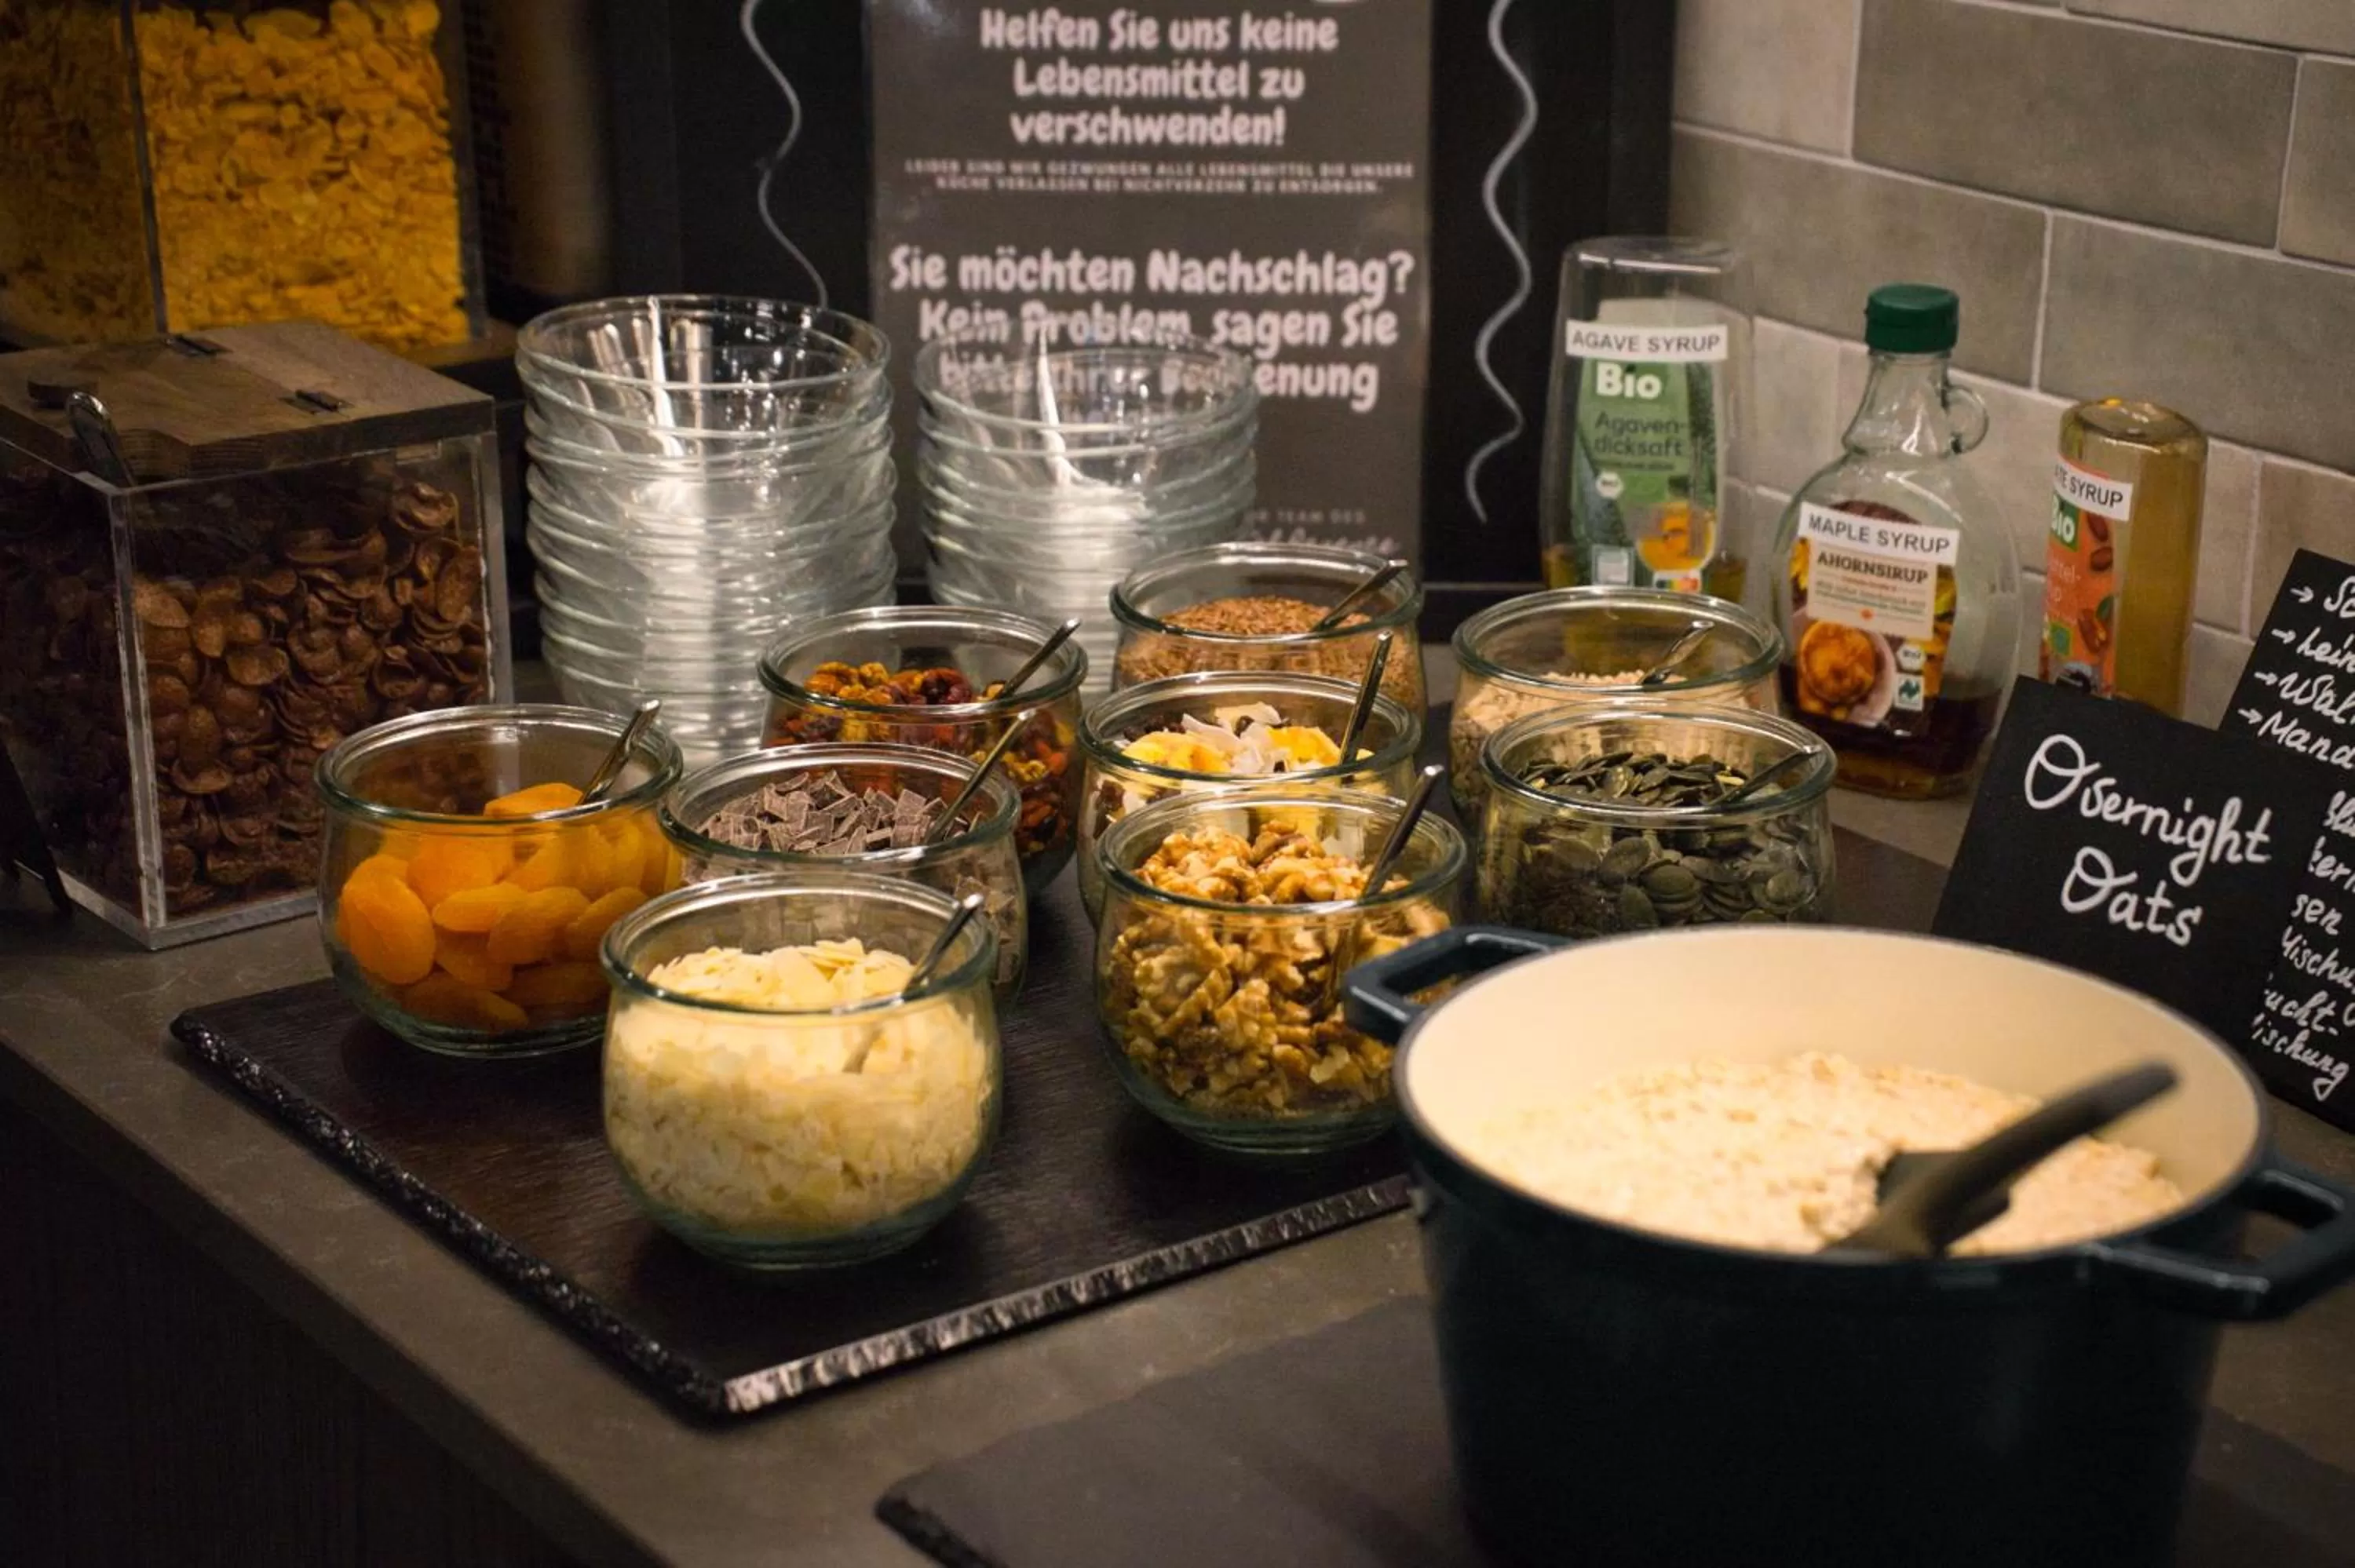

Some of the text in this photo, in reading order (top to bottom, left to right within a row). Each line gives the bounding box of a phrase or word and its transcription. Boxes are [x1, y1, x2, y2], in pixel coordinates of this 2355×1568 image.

[980, 9, 1339, 51] Helfen Sie uns keine
[1013, 57, 1305, 100] Lebensmittel zu
[1010, 106, 1287, 147] verschwenden!
[889, 246, 1415, 311] Sie möchten Nachschlag?
[918, 298, 1012, 343] Kein
[1210, 308, 1331, 359] sagen
[1340, 301, 1400, 348] Sie
[1571, 330, 1720, 354] AGAVE SYRUP
[1595, 362, 1663, 399] Bio
[1594, 434, 1683, 457] dicksaft
[2069, 476, 2123, 509] SYRUP
[1808, 513, 1950, 554] MAPLE SYRUP
[1816, 551, 1929, 584] AHORNSIRUP
[2278, 673, 2355, 727] Wal
[2024, 733, 2273, 886] Overnight
[2060, 845, 2203, 947] Oats
[2264, 990, 2339, 1036] ucht-
